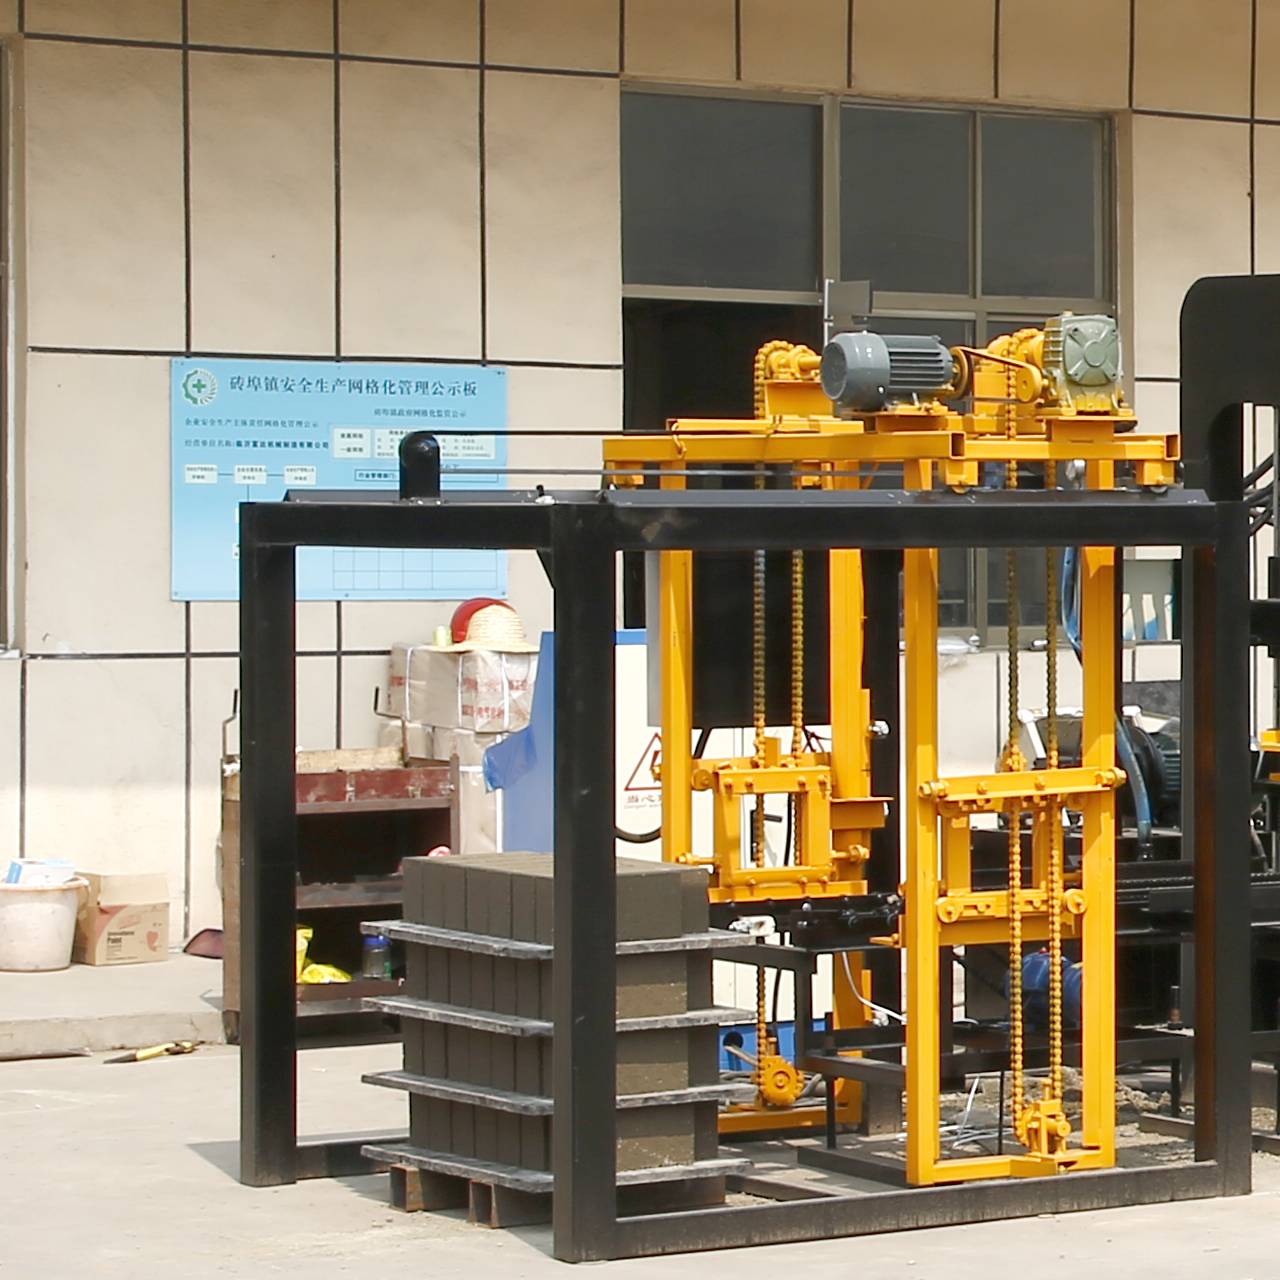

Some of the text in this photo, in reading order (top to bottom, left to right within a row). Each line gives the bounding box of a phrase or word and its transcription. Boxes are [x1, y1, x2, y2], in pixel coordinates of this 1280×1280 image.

[229, 375, 478, 397] 砖埠镇安全生产网格化管理公示板
